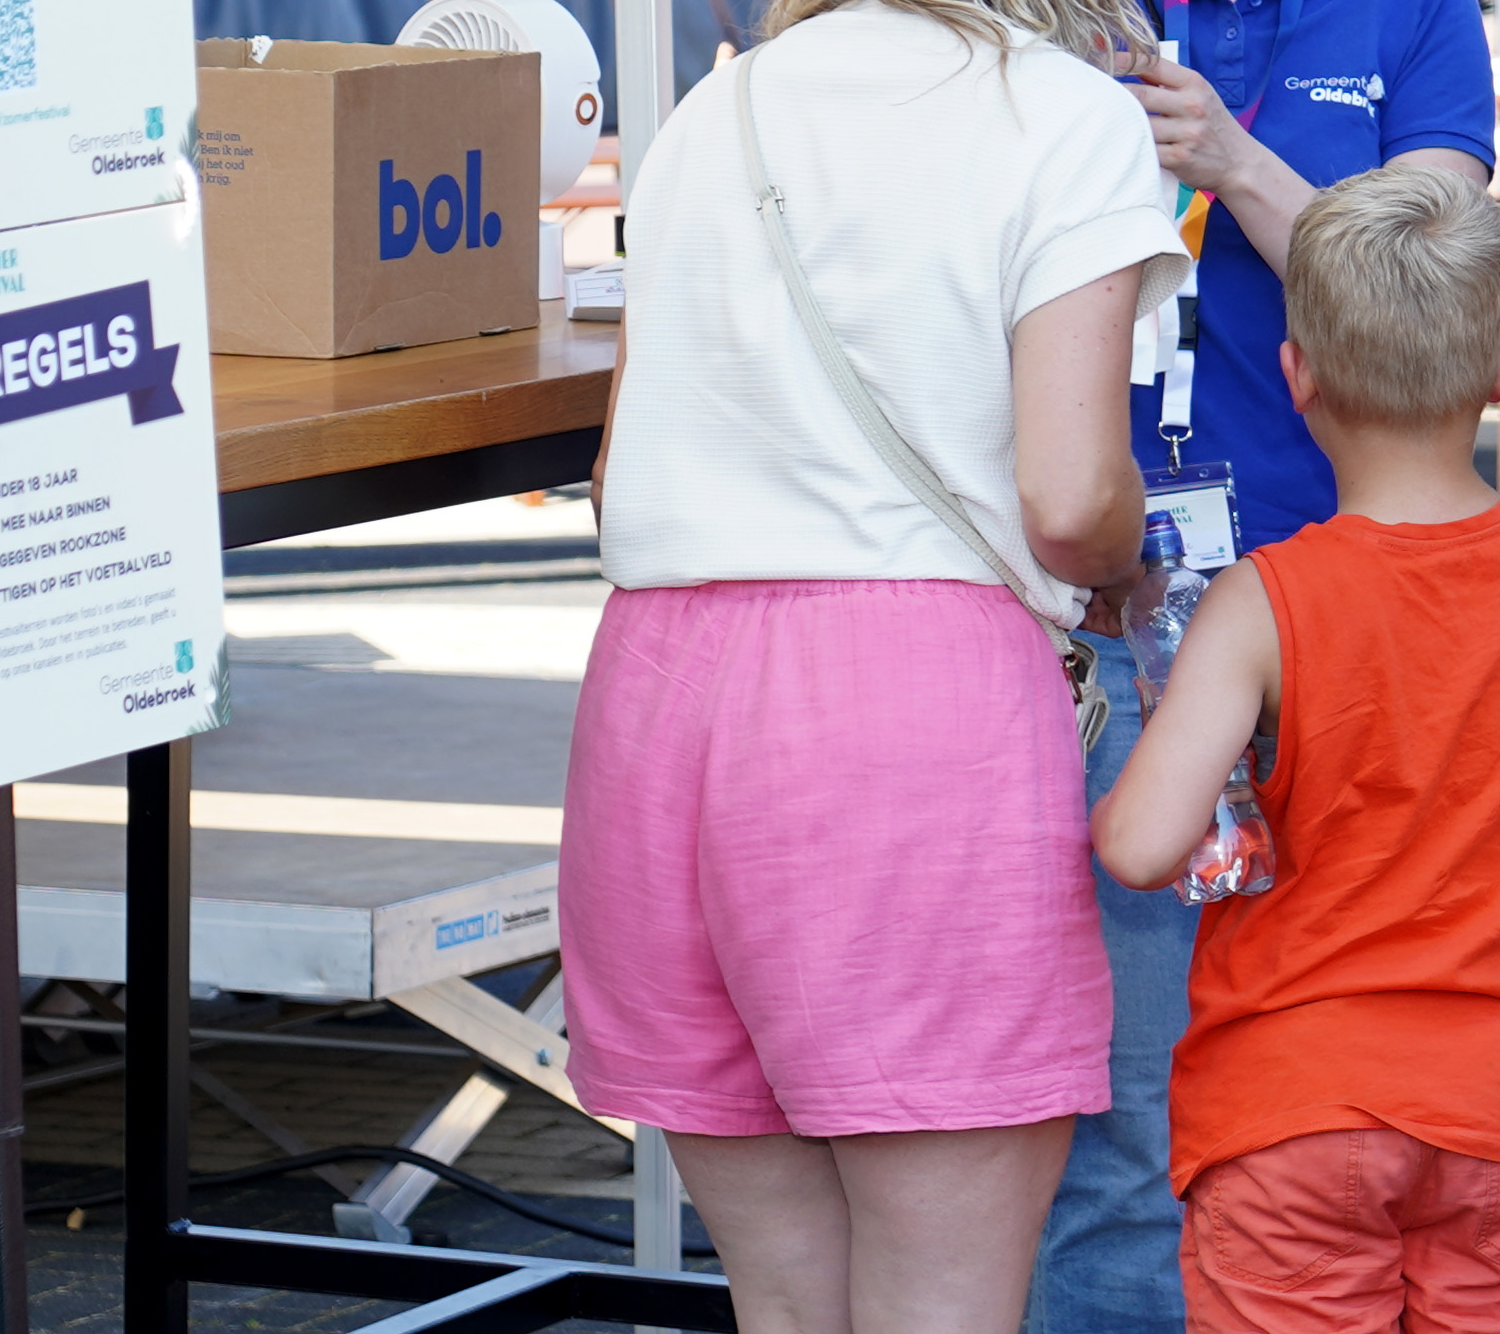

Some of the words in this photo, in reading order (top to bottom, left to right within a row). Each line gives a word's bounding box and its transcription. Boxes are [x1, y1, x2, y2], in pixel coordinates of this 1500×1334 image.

[1284, 75, 1367, 91] Gemeent
[69, 129, 144, 155] Gemeente
[201, 144, 220, 155] Ben
[223, 144, 232, 155] ik
[234, 145, 253, 156] niet
[224, 133, 241, 142] om
[92, 147, 166, 175] Oldebroek
[207, 158, 222, 169] het
[225, 160, 245, 170] oud
[379, 149, 502, 261] bol.
[28, 476, 40, 491] 18
[44, 468, 77, 488] JAAR
[1, 514, 26, 531] MEE
[29, 506, 63, 525] NAAR
[66, 497, 110, 518] BINNEN
[60, 527, 126, 553] ROOKZONE
[40, 577, 56, 593] OP
[60, 570, 82, 588] HET
[86, 551, 172, 581] VOETBALVELD
[100, 664, 174, 695] Gemeente
[123, 679, 196, 714] Oldebroek
